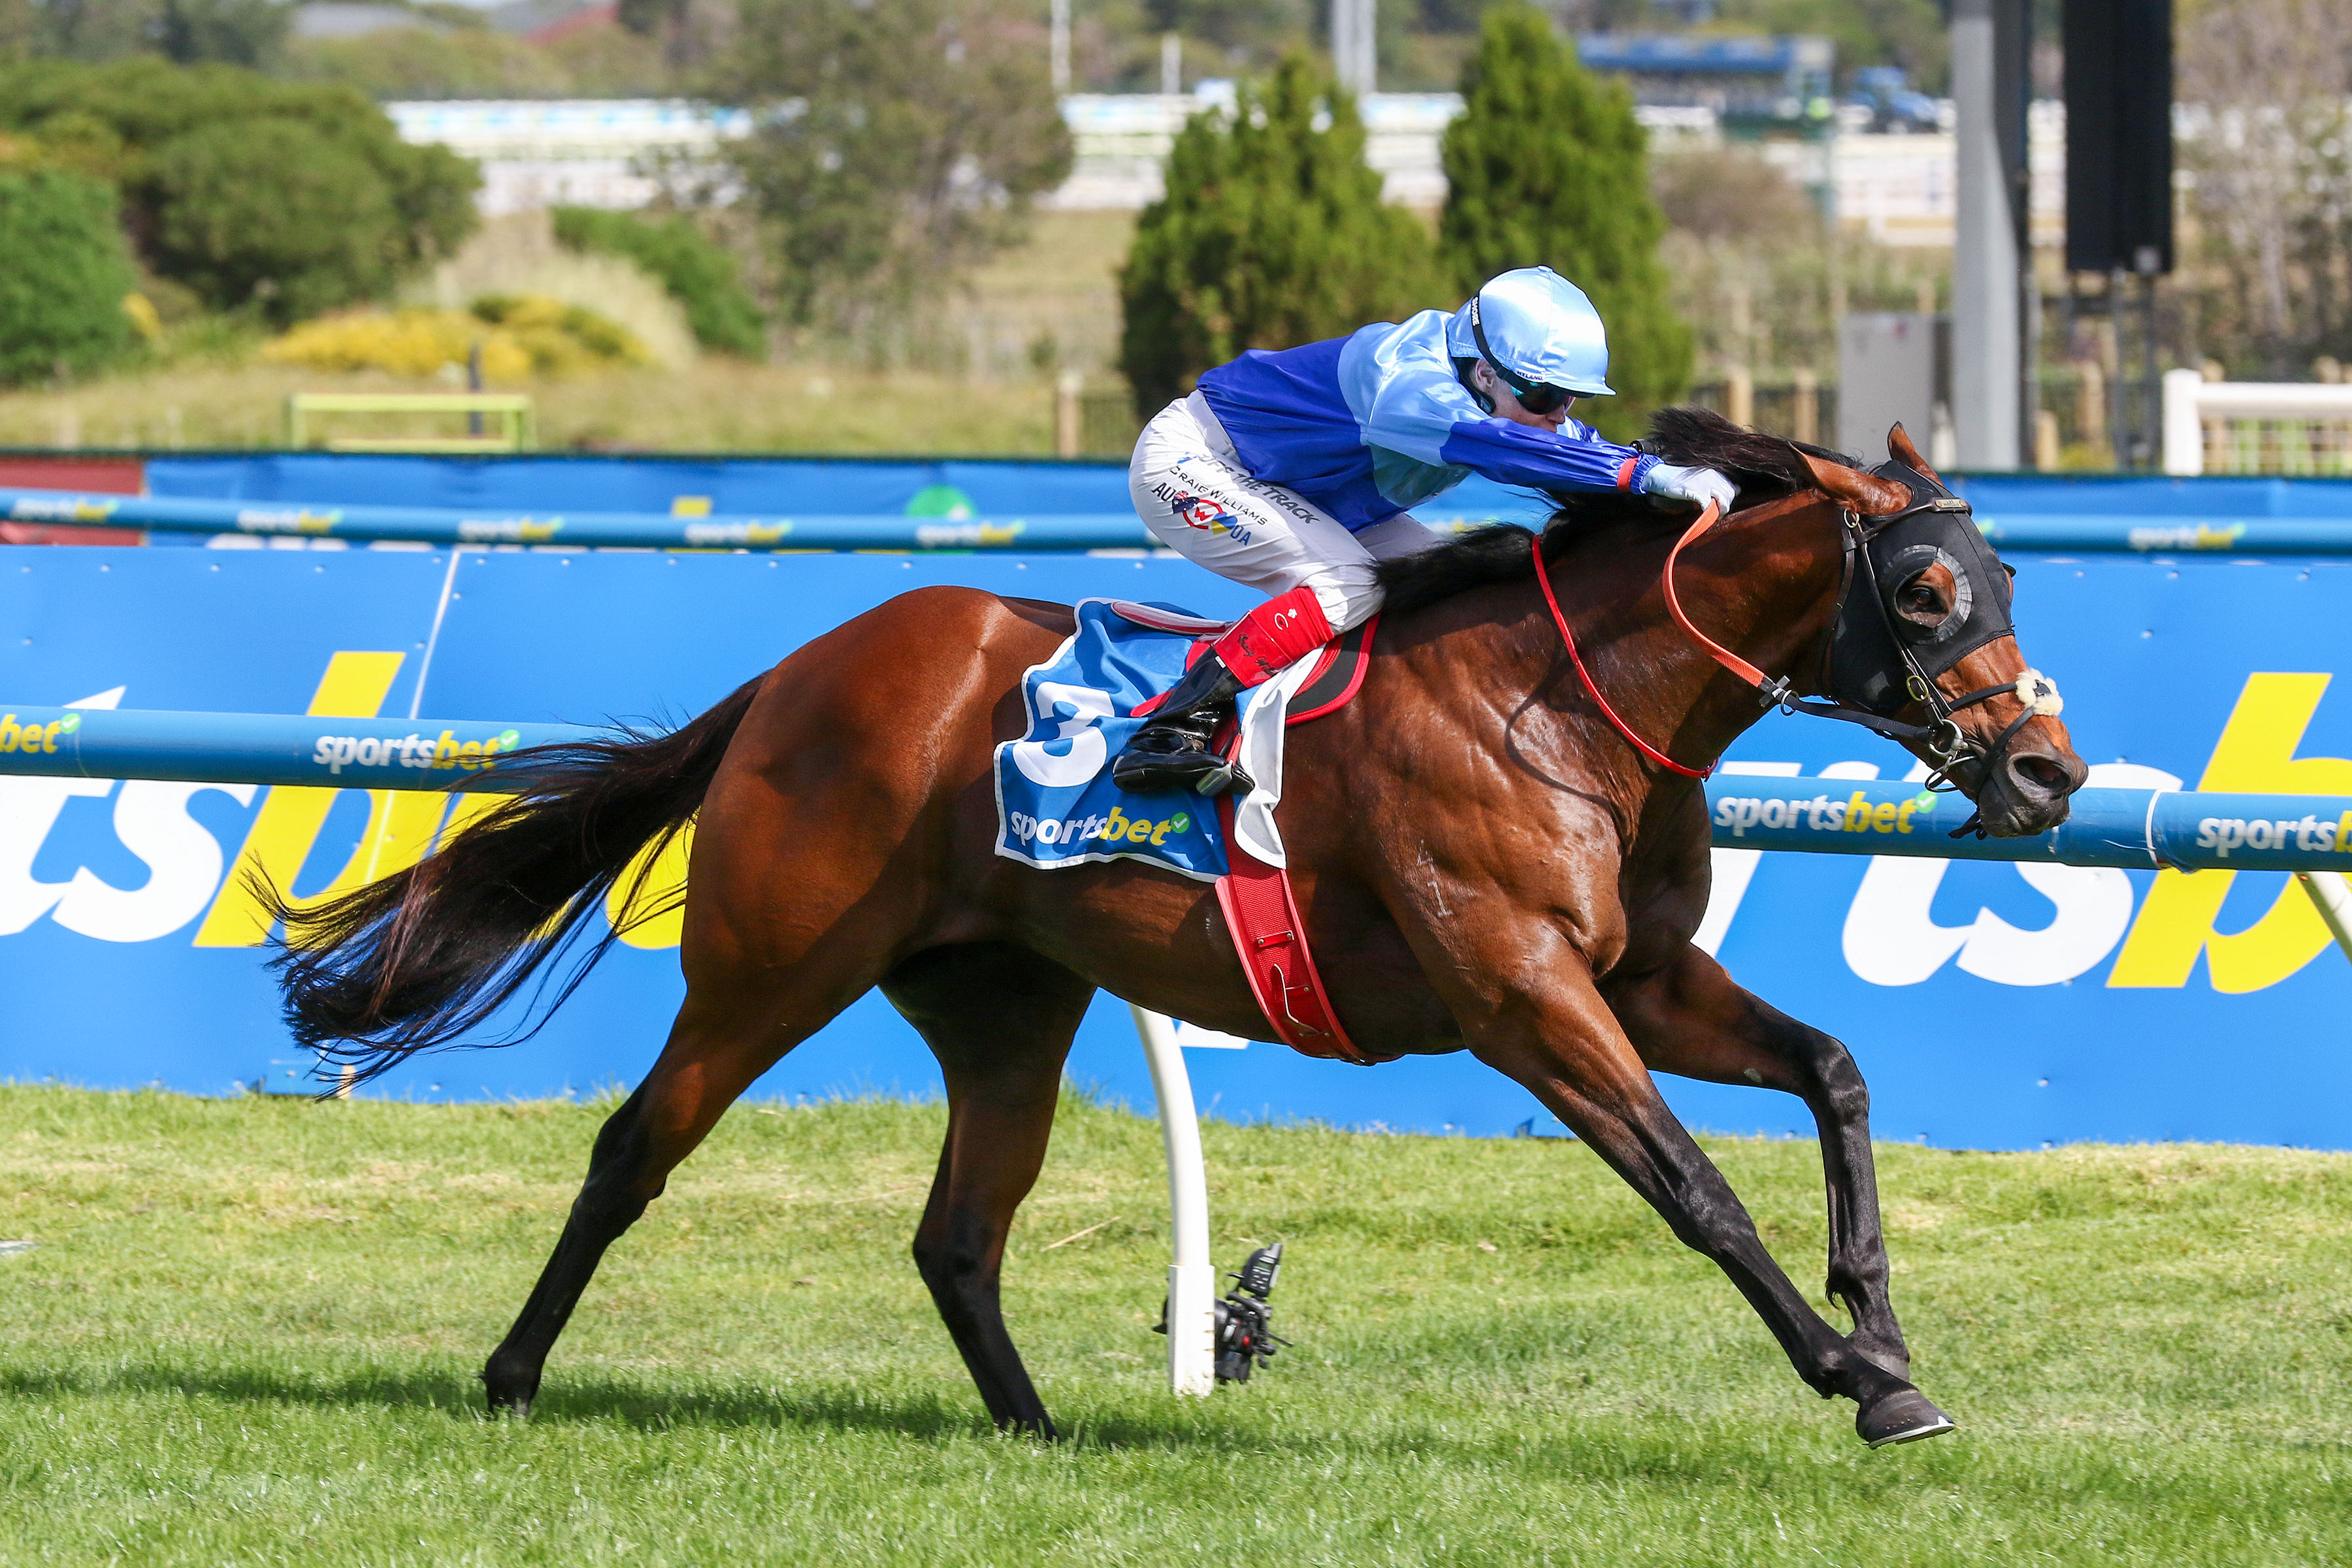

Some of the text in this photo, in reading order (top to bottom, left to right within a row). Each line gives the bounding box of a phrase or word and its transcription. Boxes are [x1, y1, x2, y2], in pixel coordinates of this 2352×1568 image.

[1169, 465, 1268, 525] CRAIG WILLIAMS
[1262, 486, 1321, 524] TRACK
[1230, 525, 1252, 546] UA
[312, 730, 500, 774] sportsbet
[1012, 681, 1115, 788] 3
[1011, 806, 1172, 846] sportsbet
[1713, 791, 1918, 837] sportsbet
